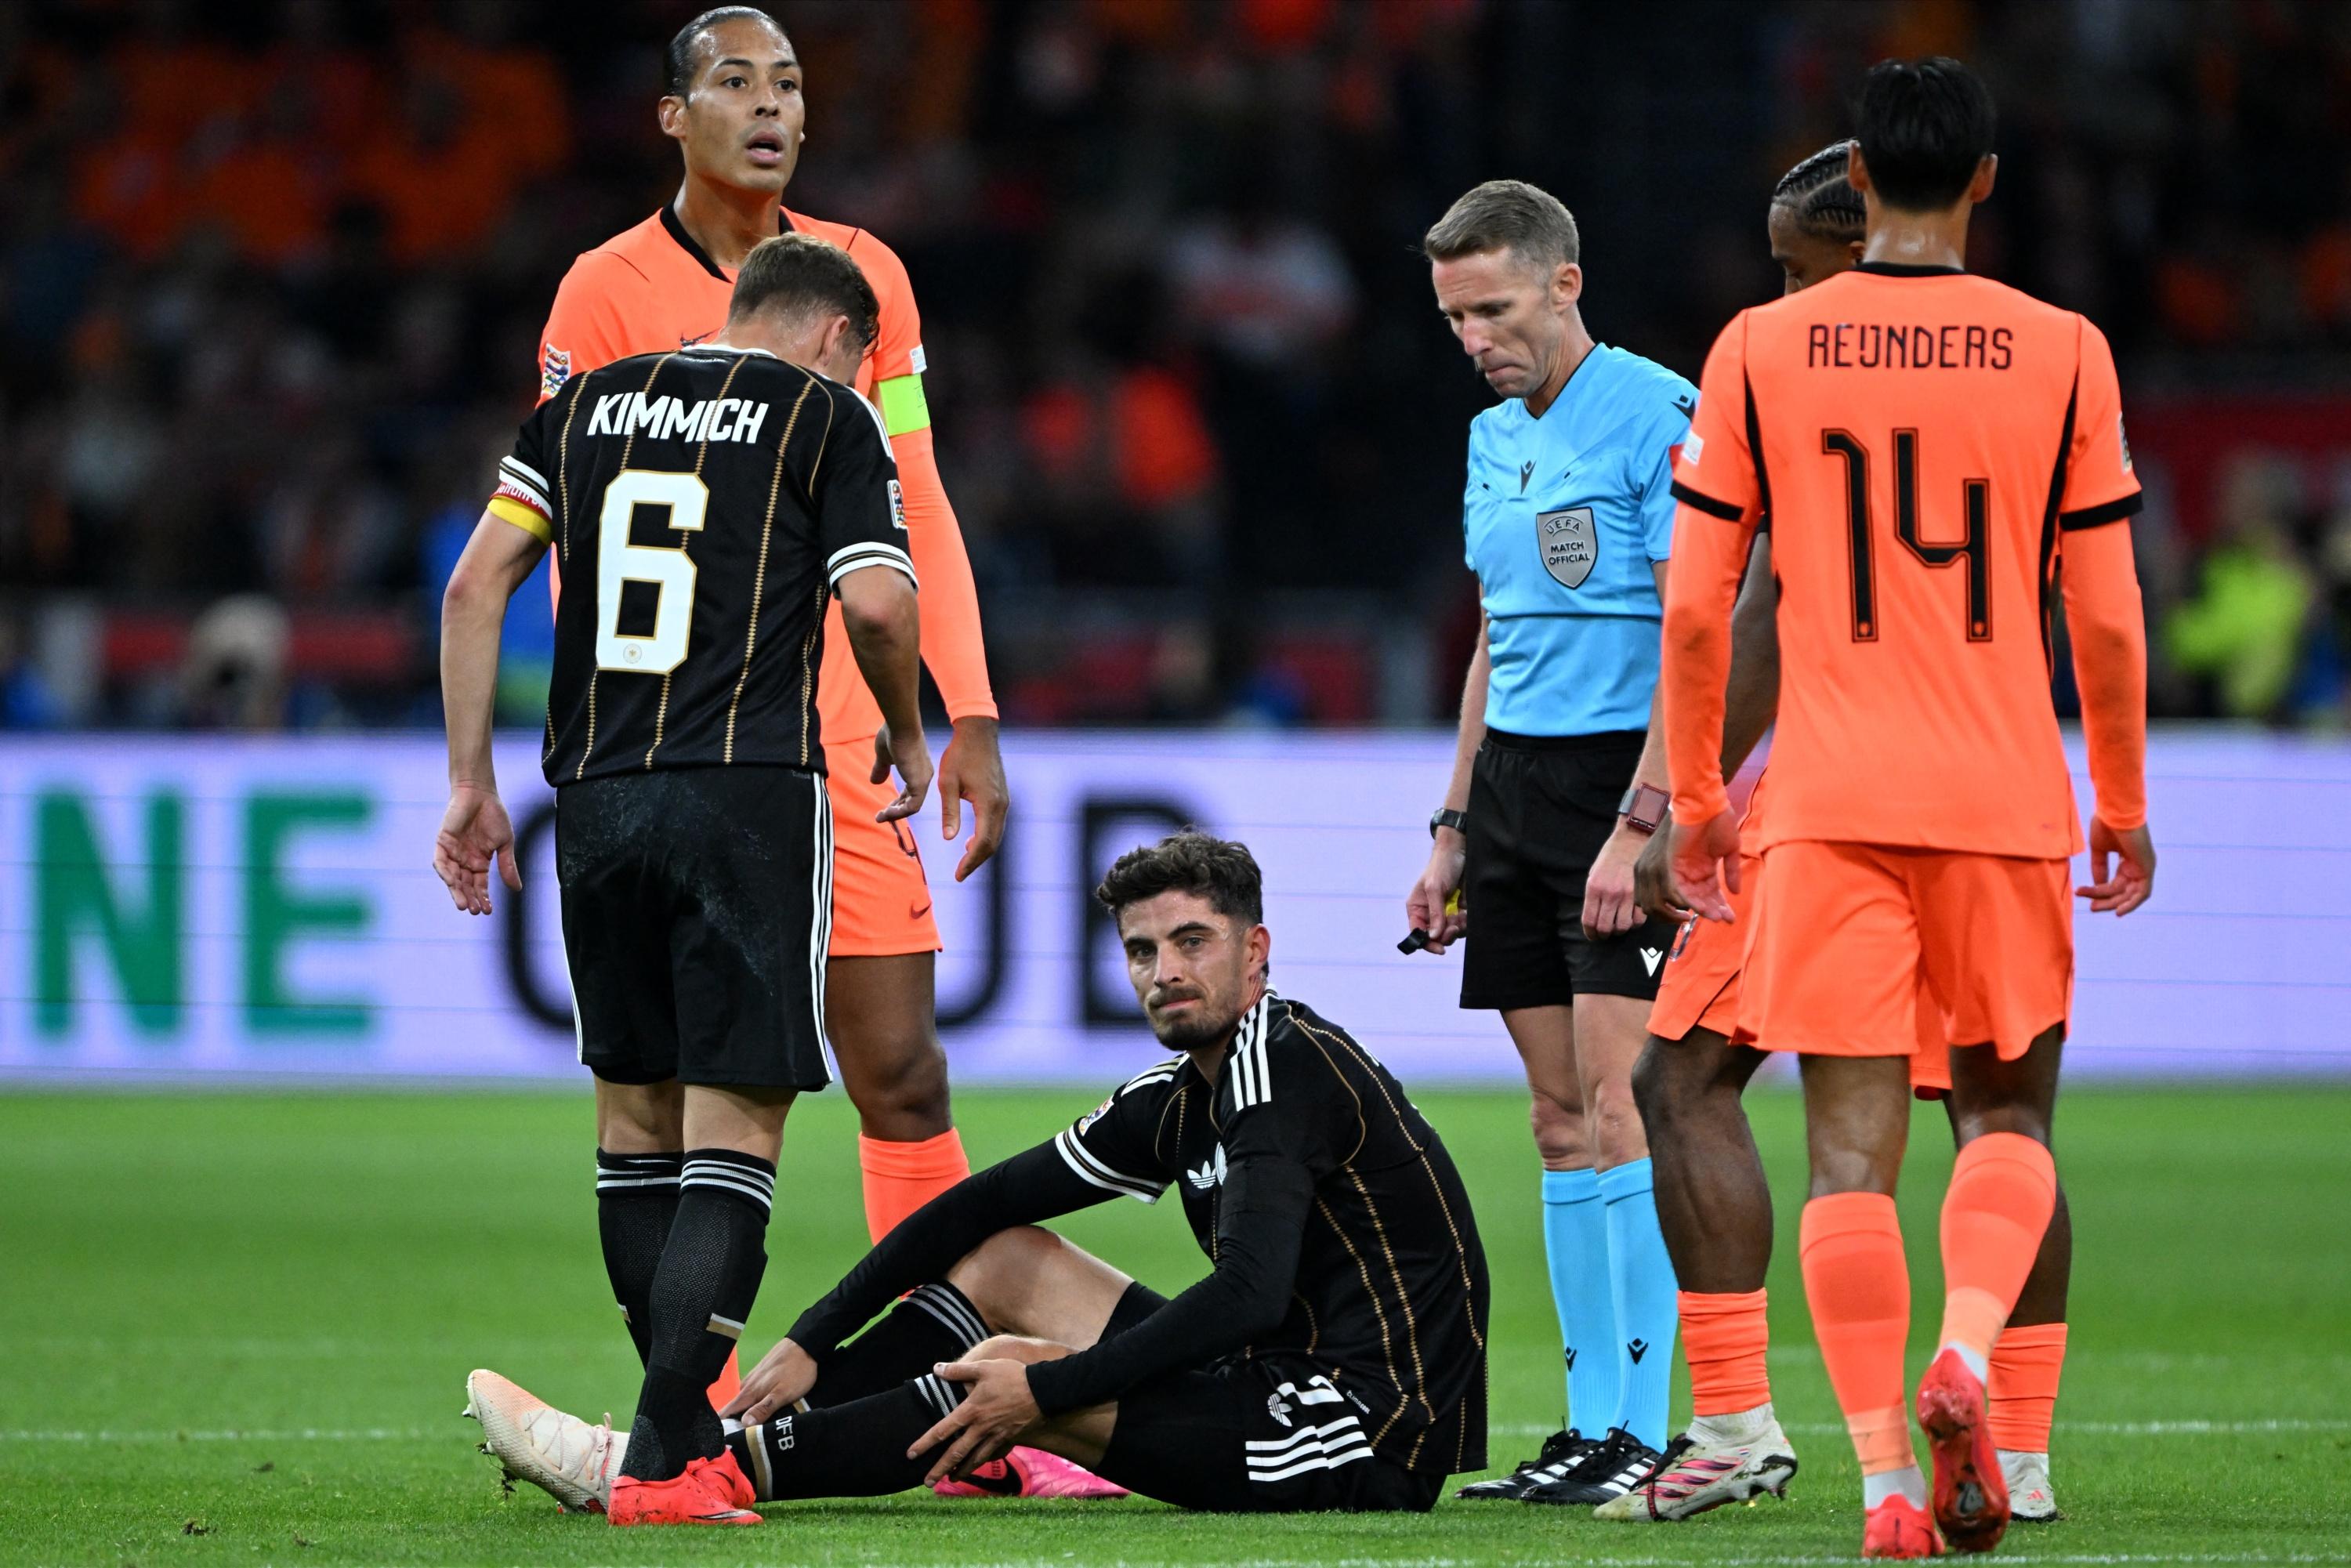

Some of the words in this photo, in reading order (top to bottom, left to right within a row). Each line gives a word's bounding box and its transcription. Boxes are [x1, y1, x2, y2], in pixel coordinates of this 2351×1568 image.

[586, 391, 770, 444] KIMMICH
[1545, 519, 1581, 534] UEFA
[1820, 427, 1993, 643] 14
[1548, 552, 1590, 566] OFFICIAL
[1550, 541, 1585, 553] MATCH
[595, 468, 710, 675] 6
[775, 1415, 795, 1450] DFB
